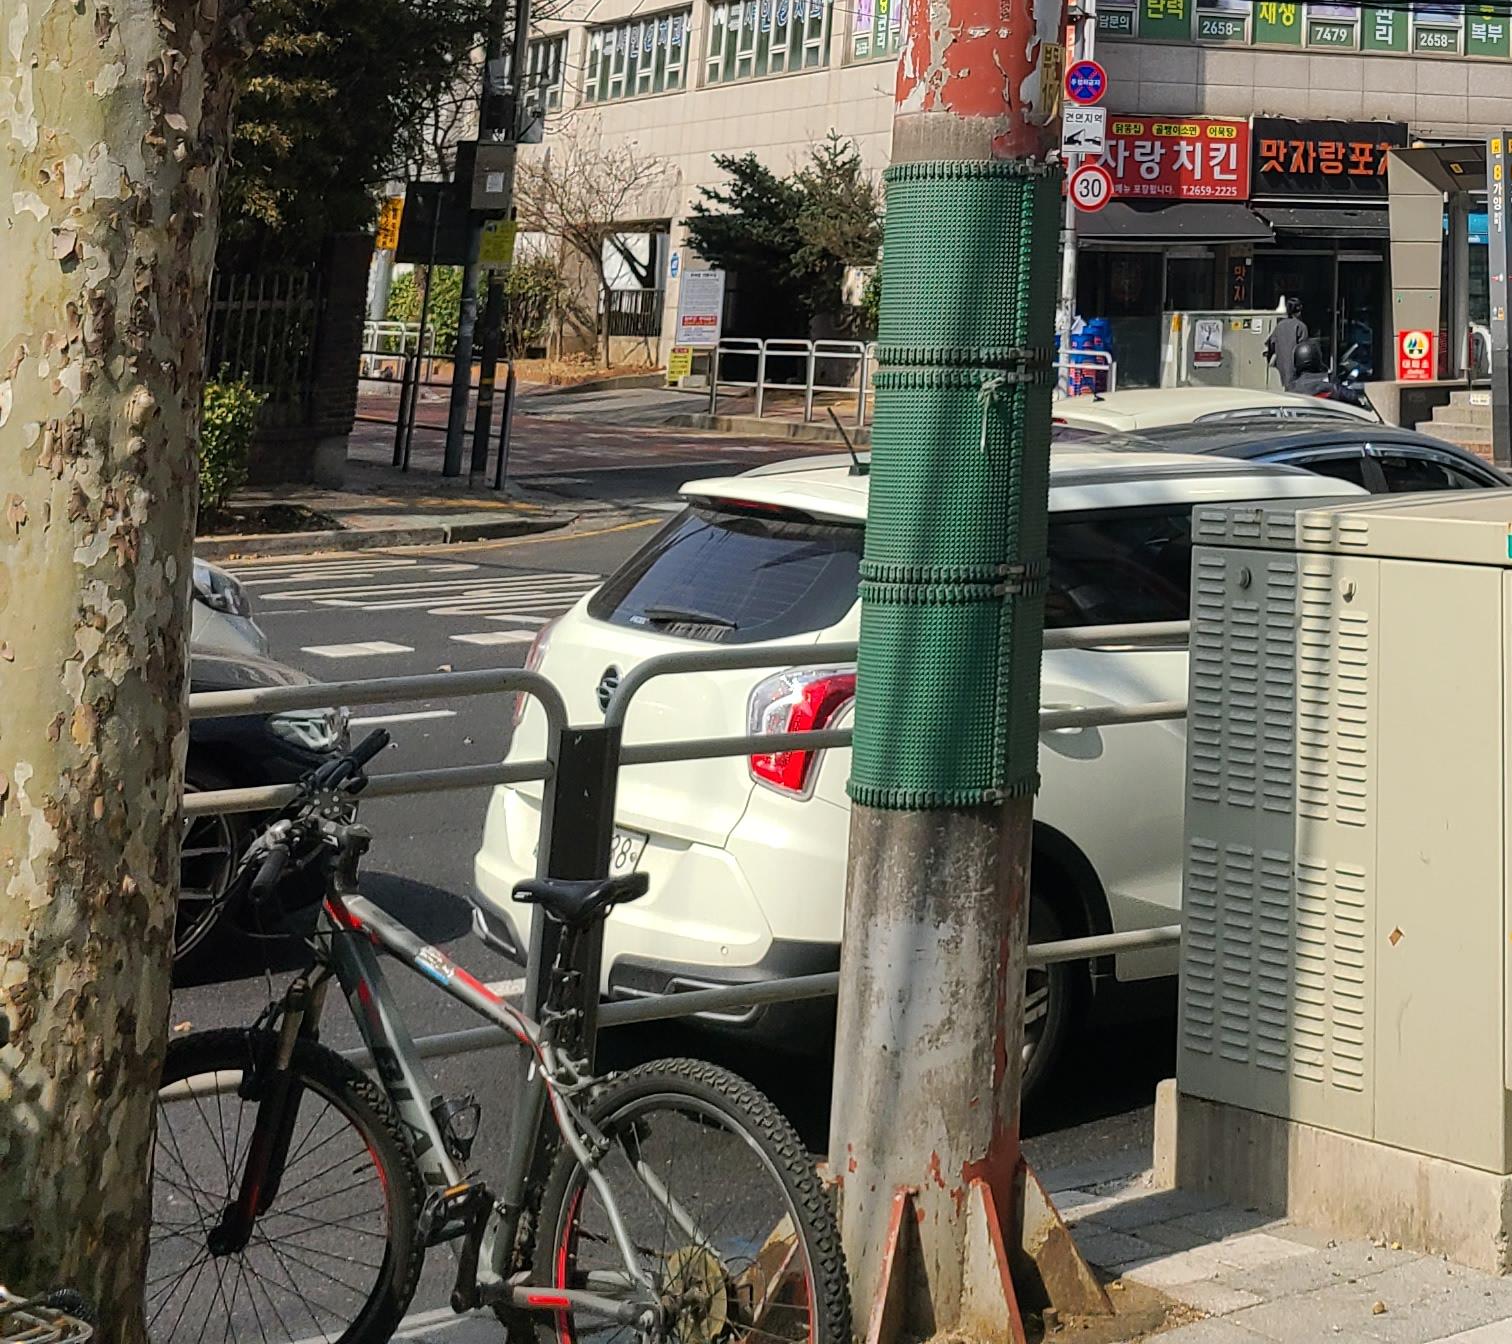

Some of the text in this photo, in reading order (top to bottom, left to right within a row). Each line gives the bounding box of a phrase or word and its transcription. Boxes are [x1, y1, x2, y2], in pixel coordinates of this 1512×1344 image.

[1260, 1, 1296, 27] 재생
[1202, 21, 1241, 36] 2658-
[1315, 27, 1348, 42] 7479
[1471, 23, 1503, 44] 복부
[1420, 33, 1456, 47] 2658-
[1065, 112, 1102, 123] 견인지역
[1068, 139, 1238, 180] 자랑치킨
[1079, 178, 1102, 198] 30
[1182, 185, 1237, 196] T.2659-2225
